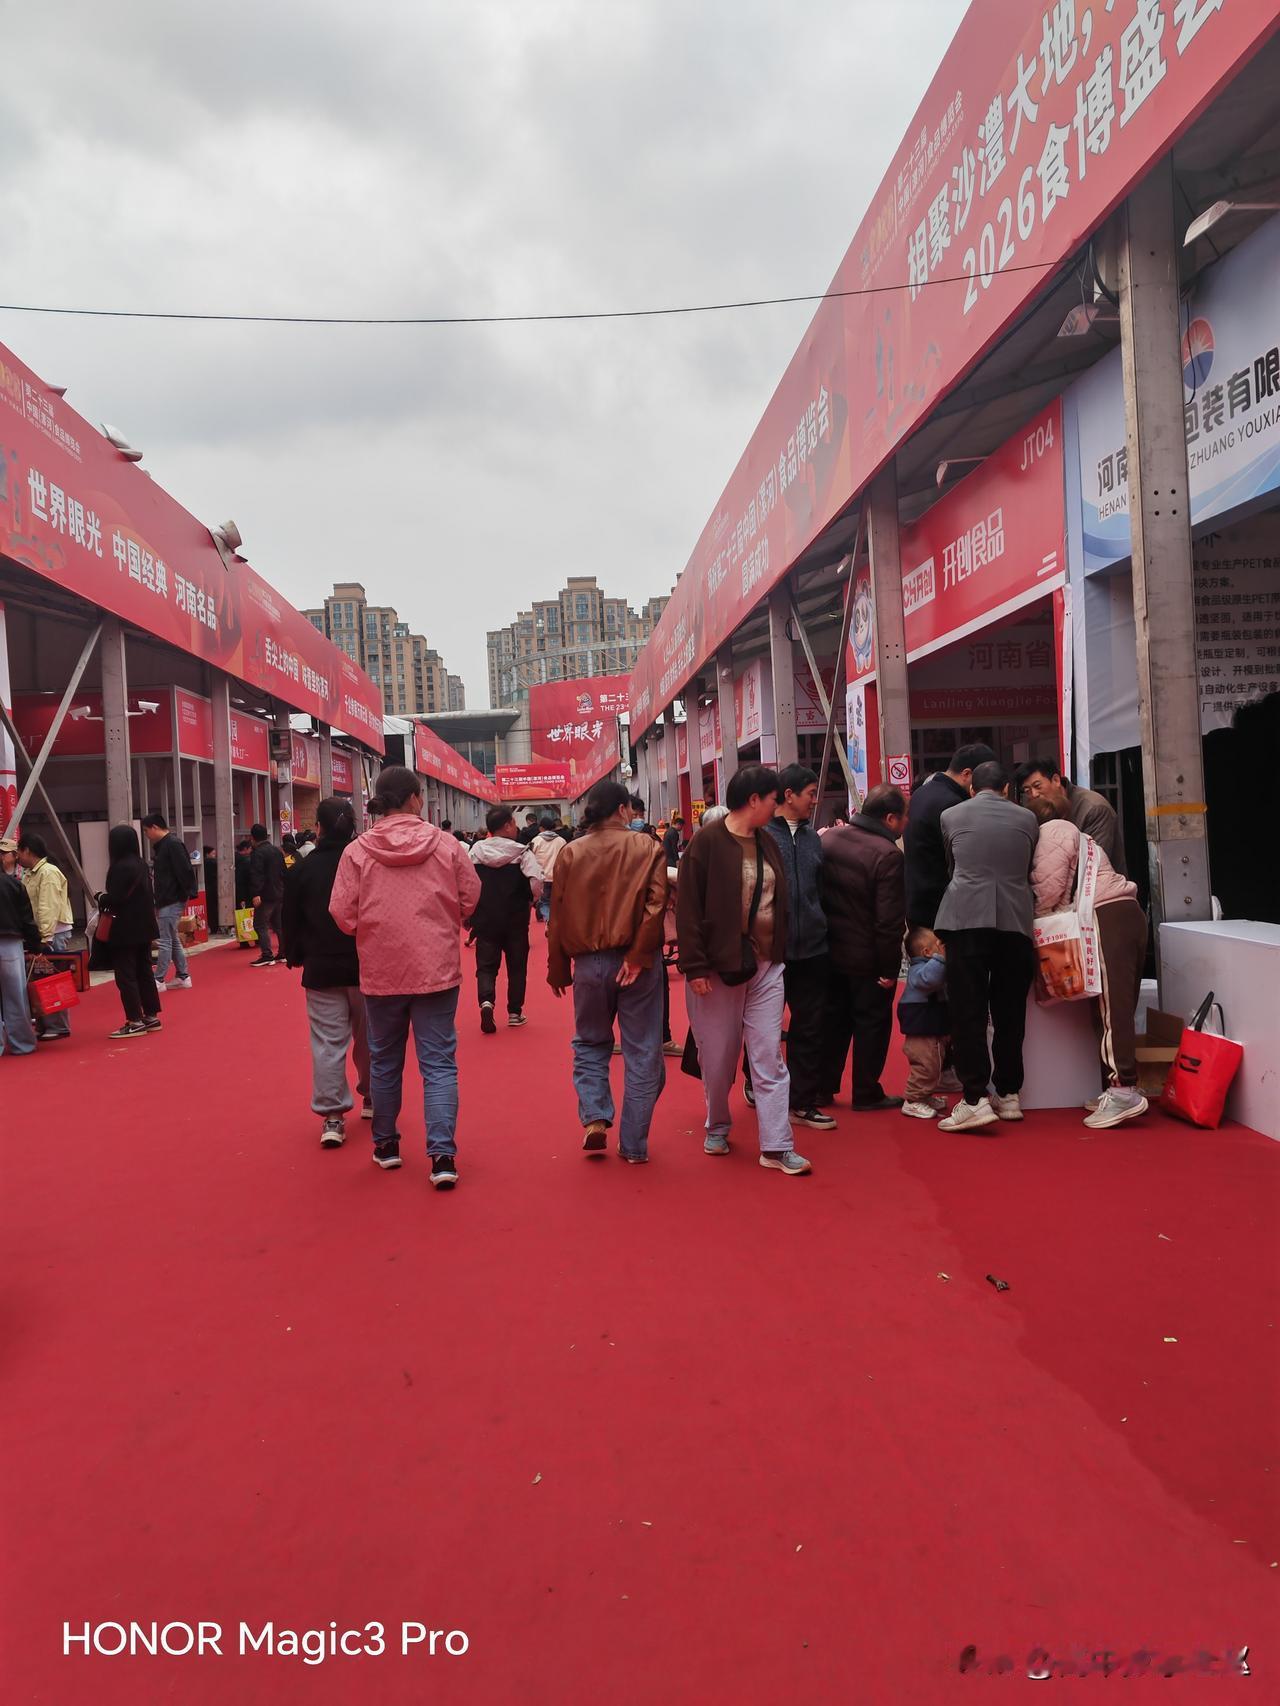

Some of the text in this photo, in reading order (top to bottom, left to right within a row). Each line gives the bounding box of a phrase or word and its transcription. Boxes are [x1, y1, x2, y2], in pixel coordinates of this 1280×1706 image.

[908, 0, 1113, 303] 相聚沙澧大地，
[1020, 417, 1054, 471] JT04
[1099, 494, 1127, 520] HENAN
[1190, 432, 1235, 470] ZHUANG
[28, 467, 103, 558] 世界眼光
[112, 530, 168, 598] 中国经典
[174, 572, 217, 631] 河南名品
[942, 507, 1005, 591] 开创食品
[1194, 576, 1235, 589] 决方案。
[547, 720, 603, 745] 世界眼光
